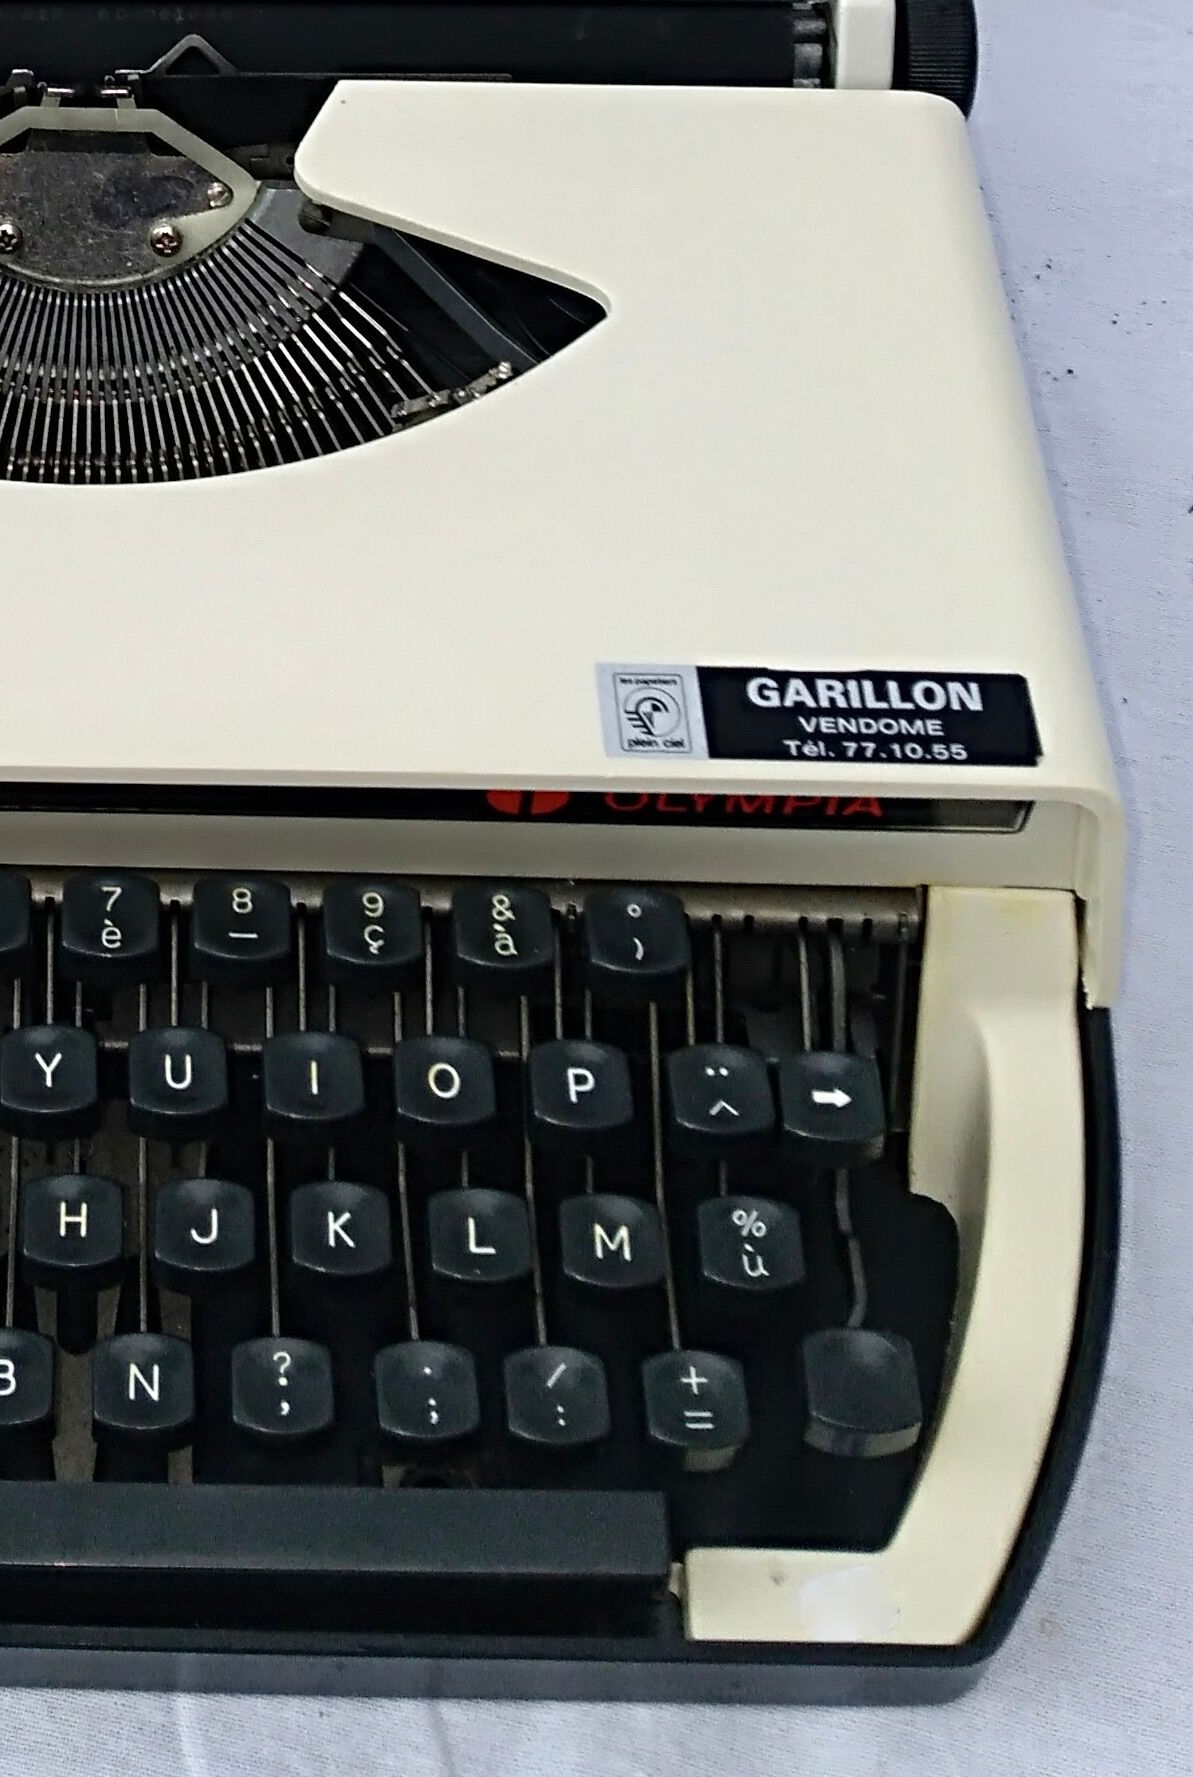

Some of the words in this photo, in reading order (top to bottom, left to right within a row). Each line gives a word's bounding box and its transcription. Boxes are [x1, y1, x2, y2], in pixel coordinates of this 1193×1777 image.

[746, 677, 984, 712] GARILLON
[797, 716, 945, 736] VENDOME
[782, 739, 836, 758] Tél.
[842, 741, 969, 761] 77.10.55
[606, 791, 884, 817] OLYMPIA
[101, 886, 122, 911] 7
[232, 888, 253, 913] 8
[362, 892, 384, 917] 9
[492, 894, 516, 921] &
[101, 918, 122, 949] è
[364, 925, 384, 954] ç
[493, 923, 518, 956] à
[34, 1052, 62, 1088] Y
[164, 1054, 192, 1090] U
[310, 1060, 318, 1095] I
[428, 1062, 461, 1099] O
[567, 1067, 595, 1103] P
[59, 1201, 88, 1238] H
[190, 1208, 218, 1244] J
[327, 1211, 355, 1248] K
[468, 1217, 497, 1255] L
[732, 1209, 767, 1237] %
[594, 1223, 631, 1261] M
[742, 1243, 770, 1277] ù
[128, 1363, 160, 1402] N
[272, 1351, 291, 1386] ?
[681, 1366, 708, 1395] +
[684, 1411, 714, 1429] =
